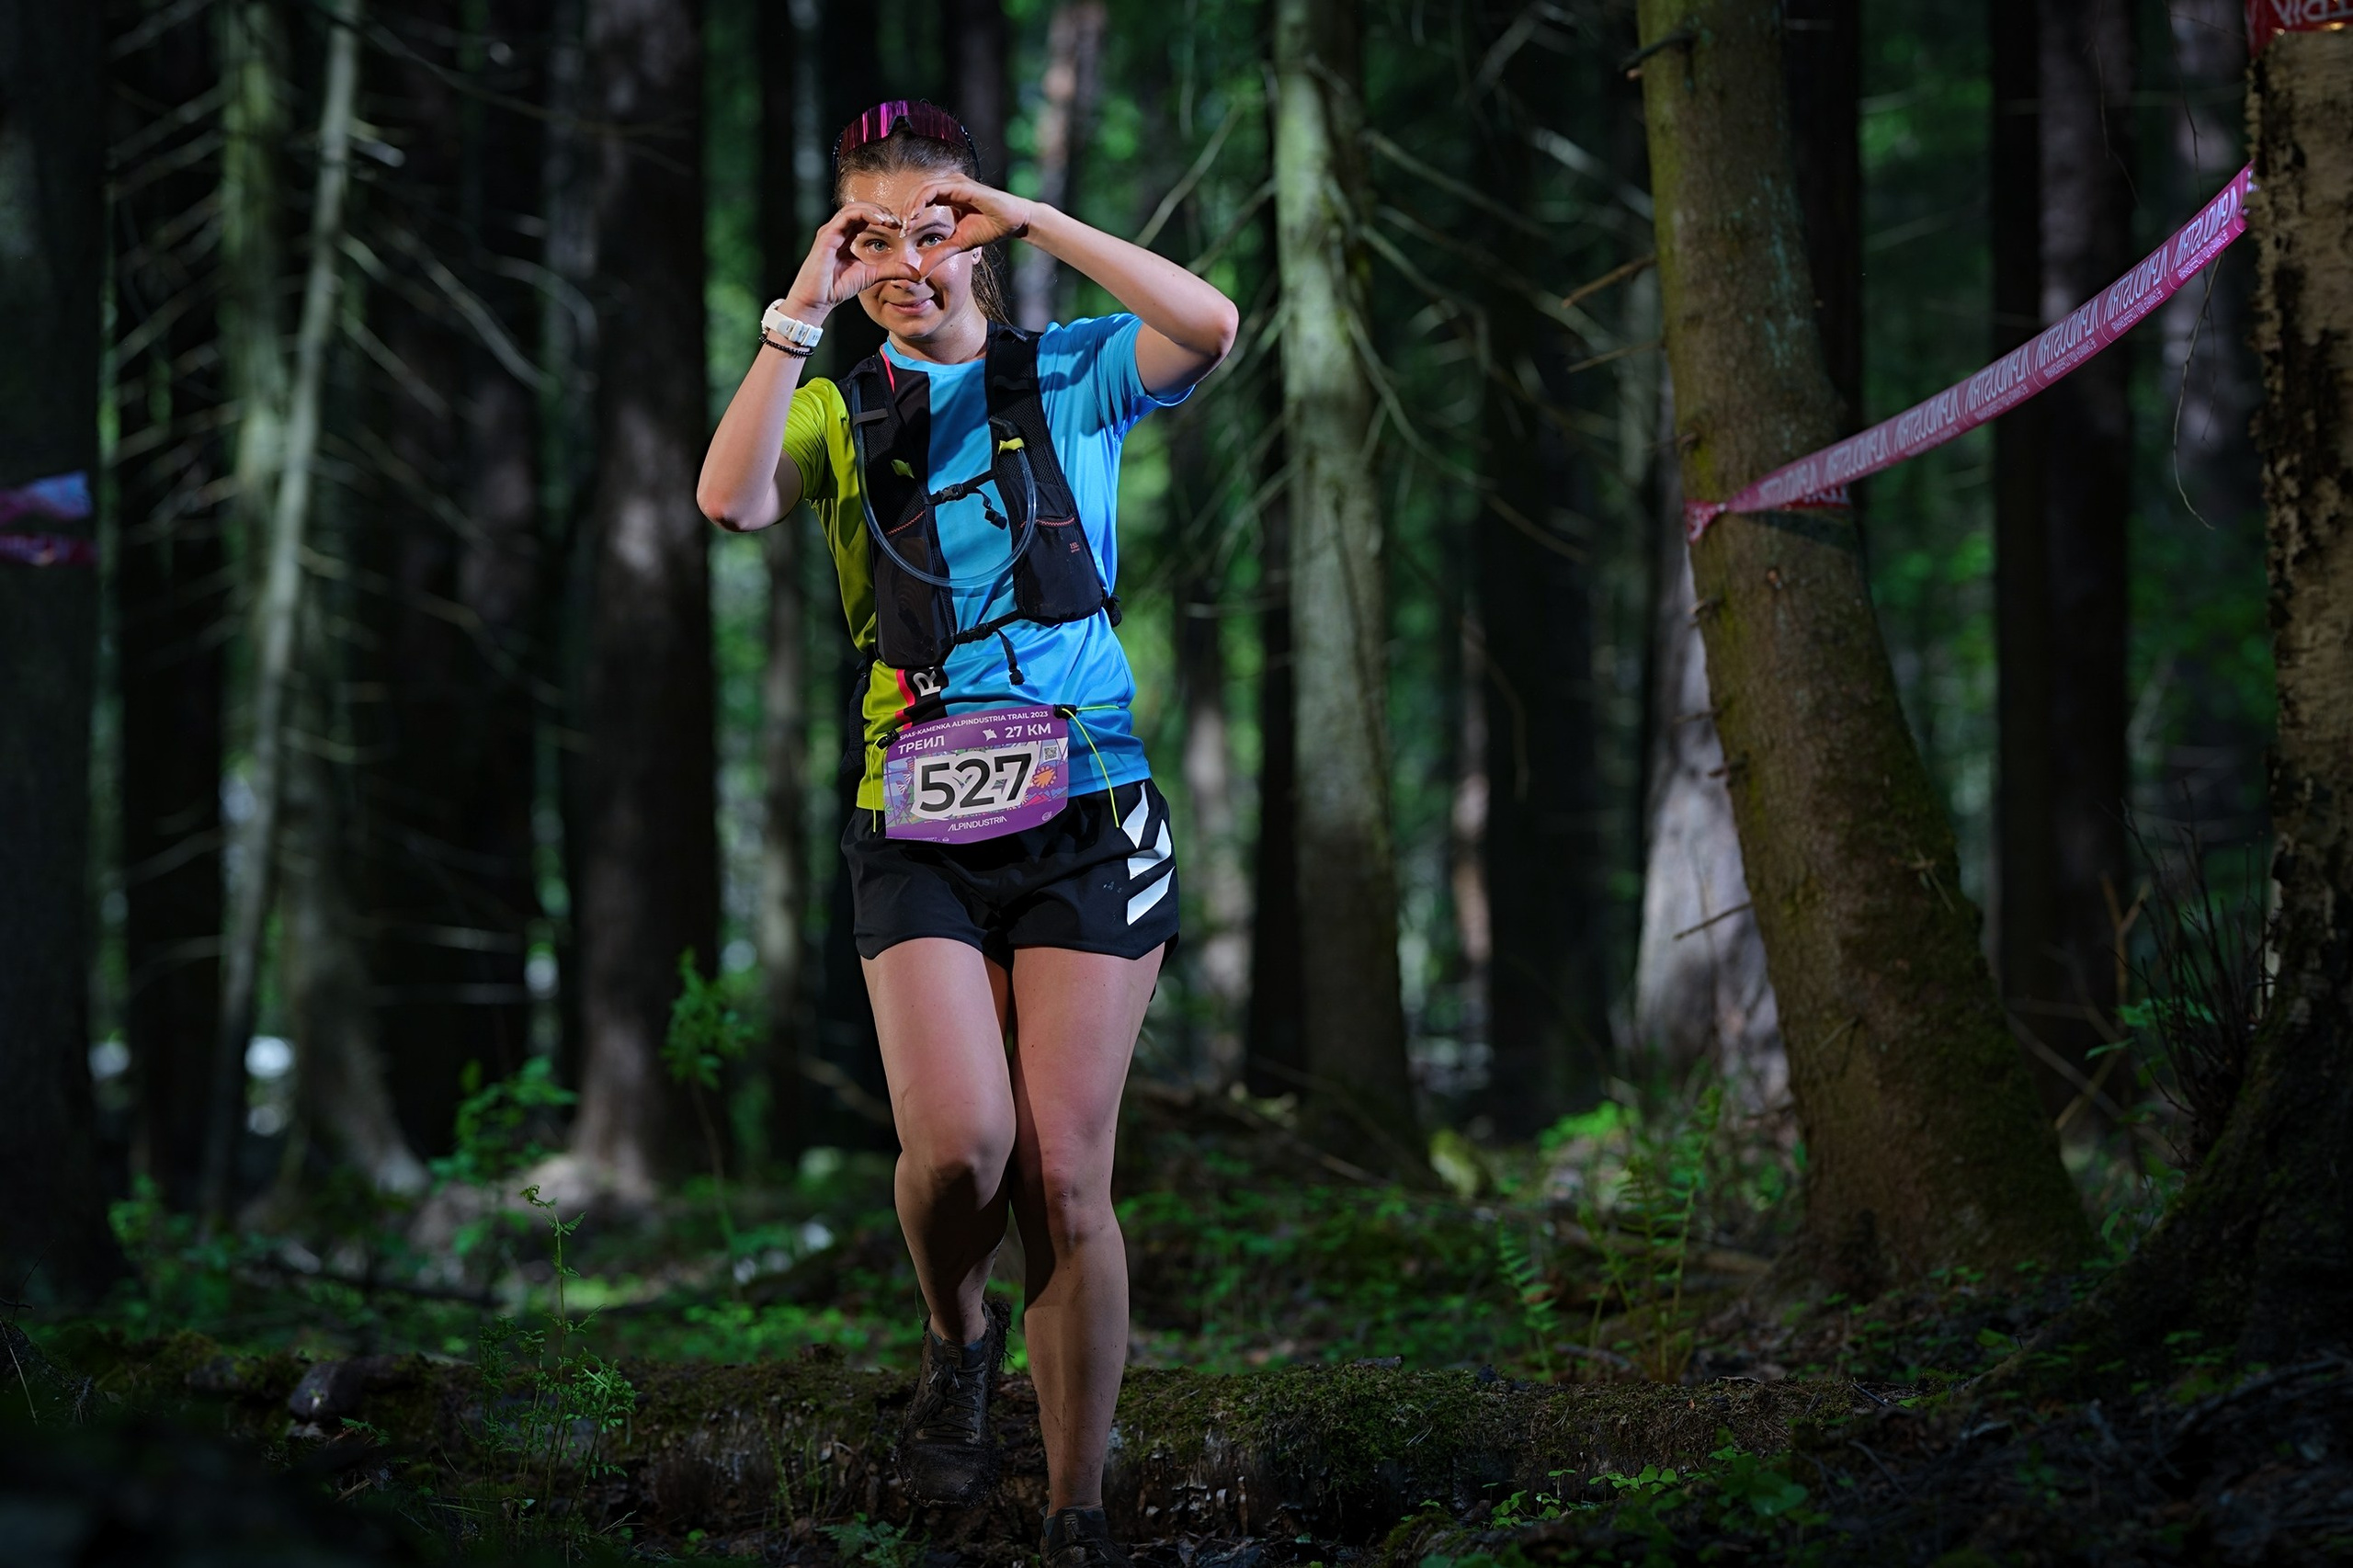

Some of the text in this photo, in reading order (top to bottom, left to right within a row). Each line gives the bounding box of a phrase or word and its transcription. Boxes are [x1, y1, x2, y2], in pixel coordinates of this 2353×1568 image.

[913, 666, 941, 697] R
[951, 714, 1006, 728] ALPINDUSTRIA
[1007, 712, 1029, 721] TRAIL
[1030, 710, 1049, 719] 2023
[1005, 726, 1023, 739] 27
[919, 753, 1032, 812] 527
[948, 815, 1007, 832] ALPINDUSTRIA
